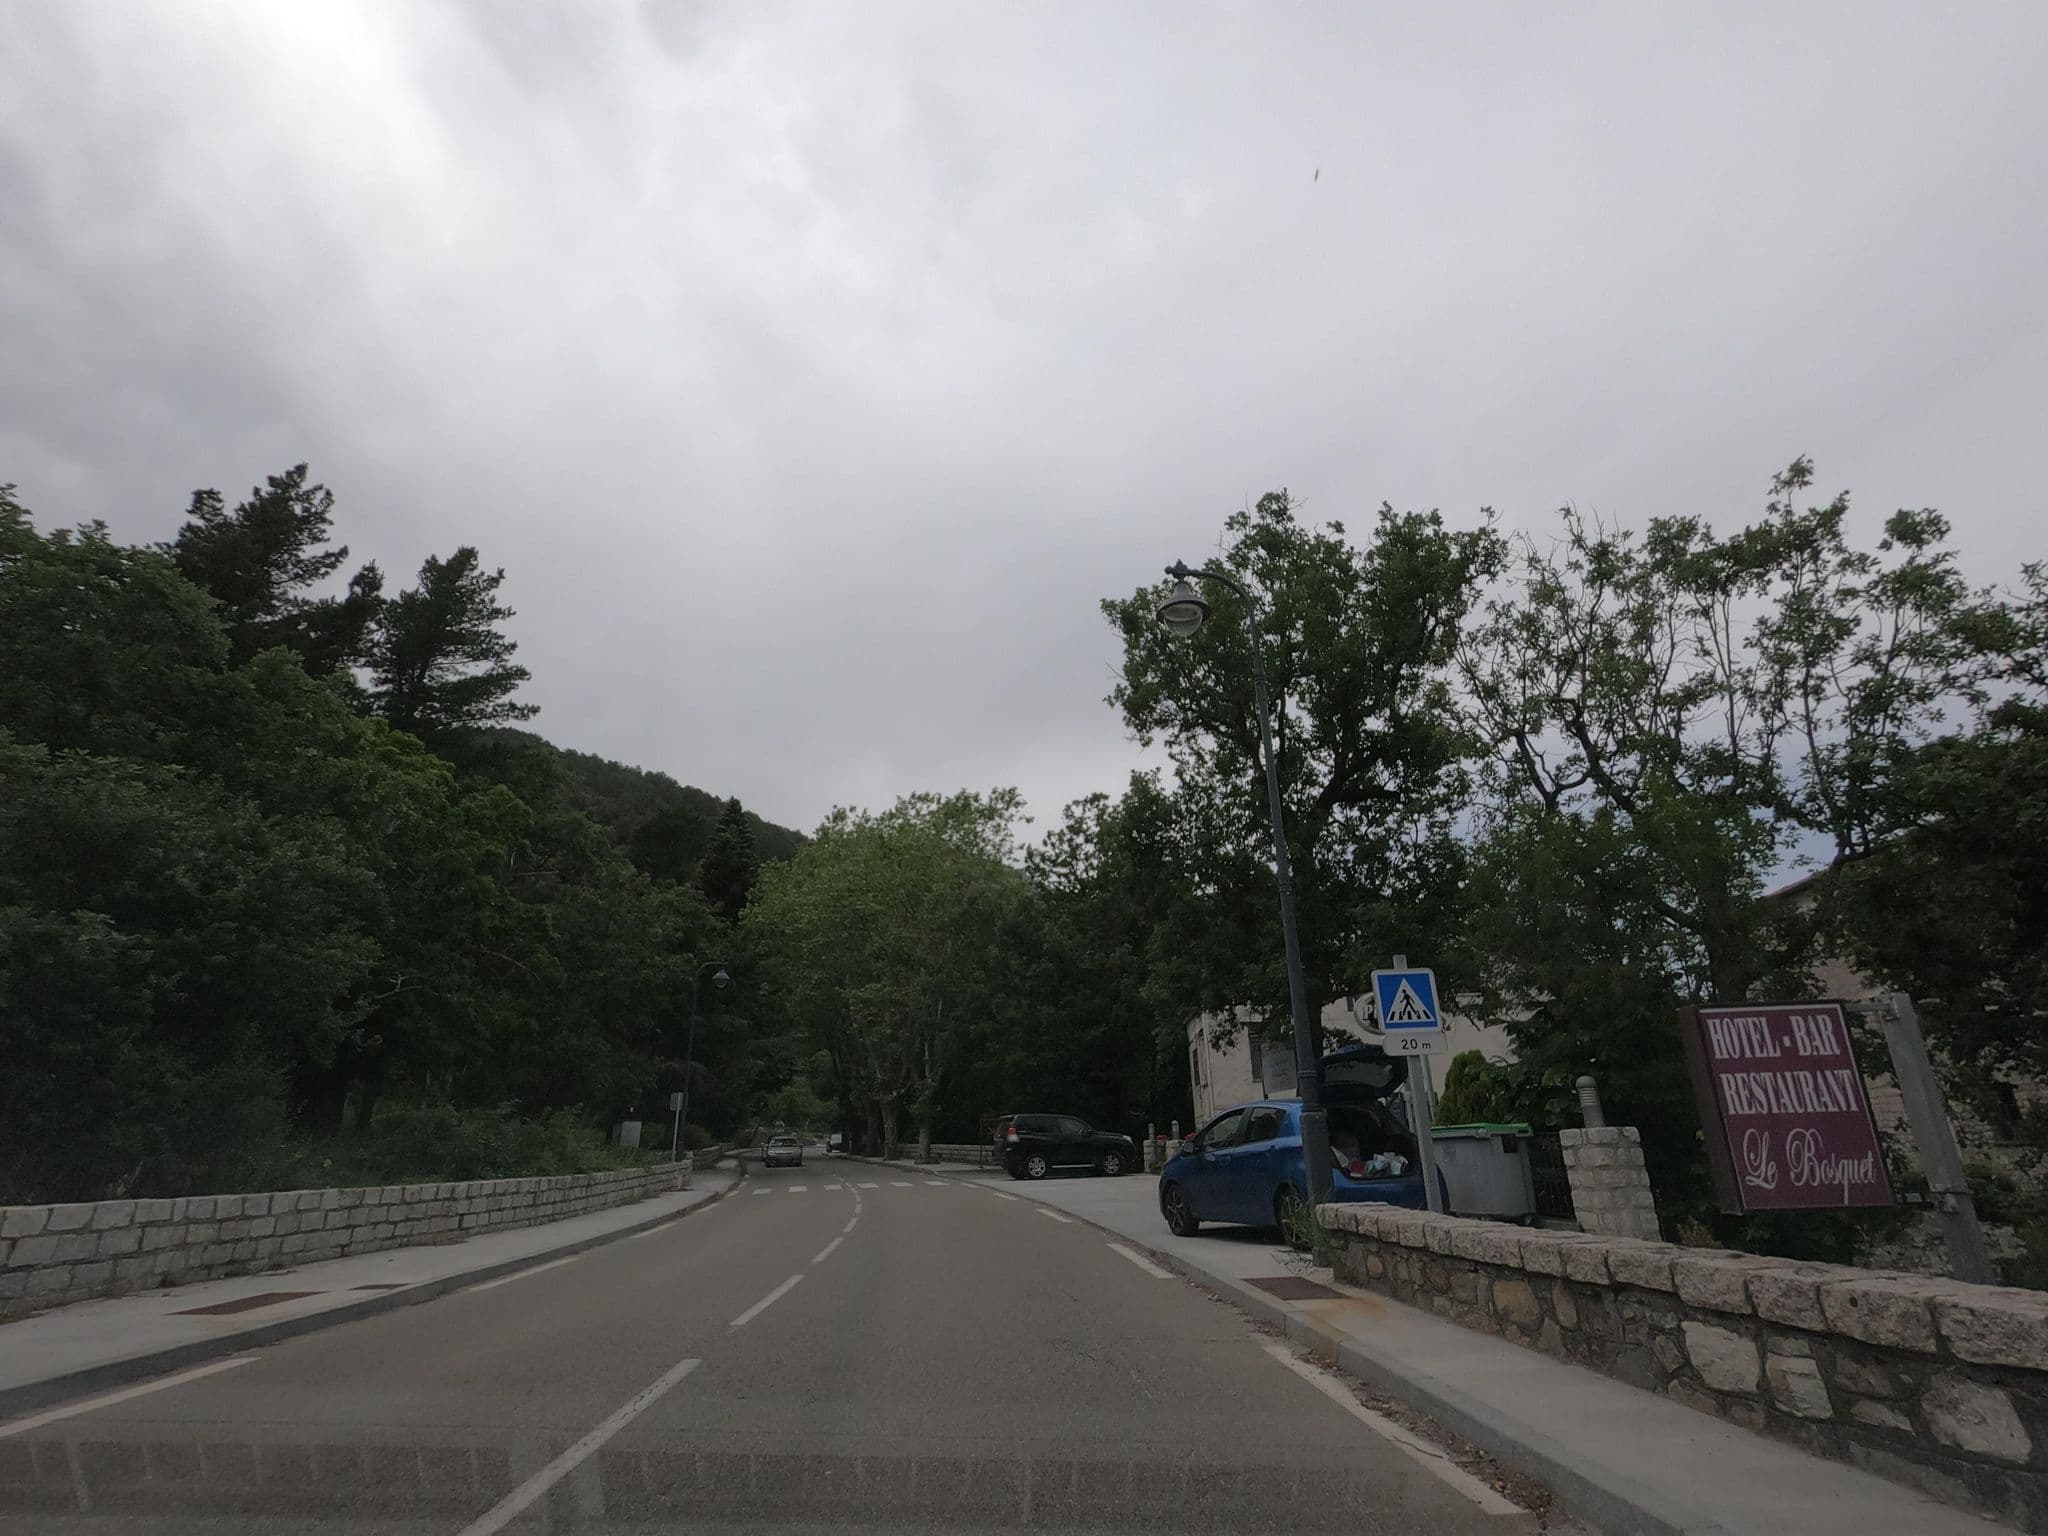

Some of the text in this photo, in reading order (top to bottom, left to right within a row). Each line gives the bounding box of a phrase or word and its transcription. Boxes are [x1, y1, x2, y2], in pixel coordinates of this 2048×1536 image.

[1400, 1038, 1432, 1050] 20 m
[1706, 1016, 1781, 1060] HOTEL
[1789, 1014, 1841, 1057] BAR
[1718, 1069, 1860, 1115] RESTAURANT
[1743, 1127, 1877, 1205] Le Bosquet
